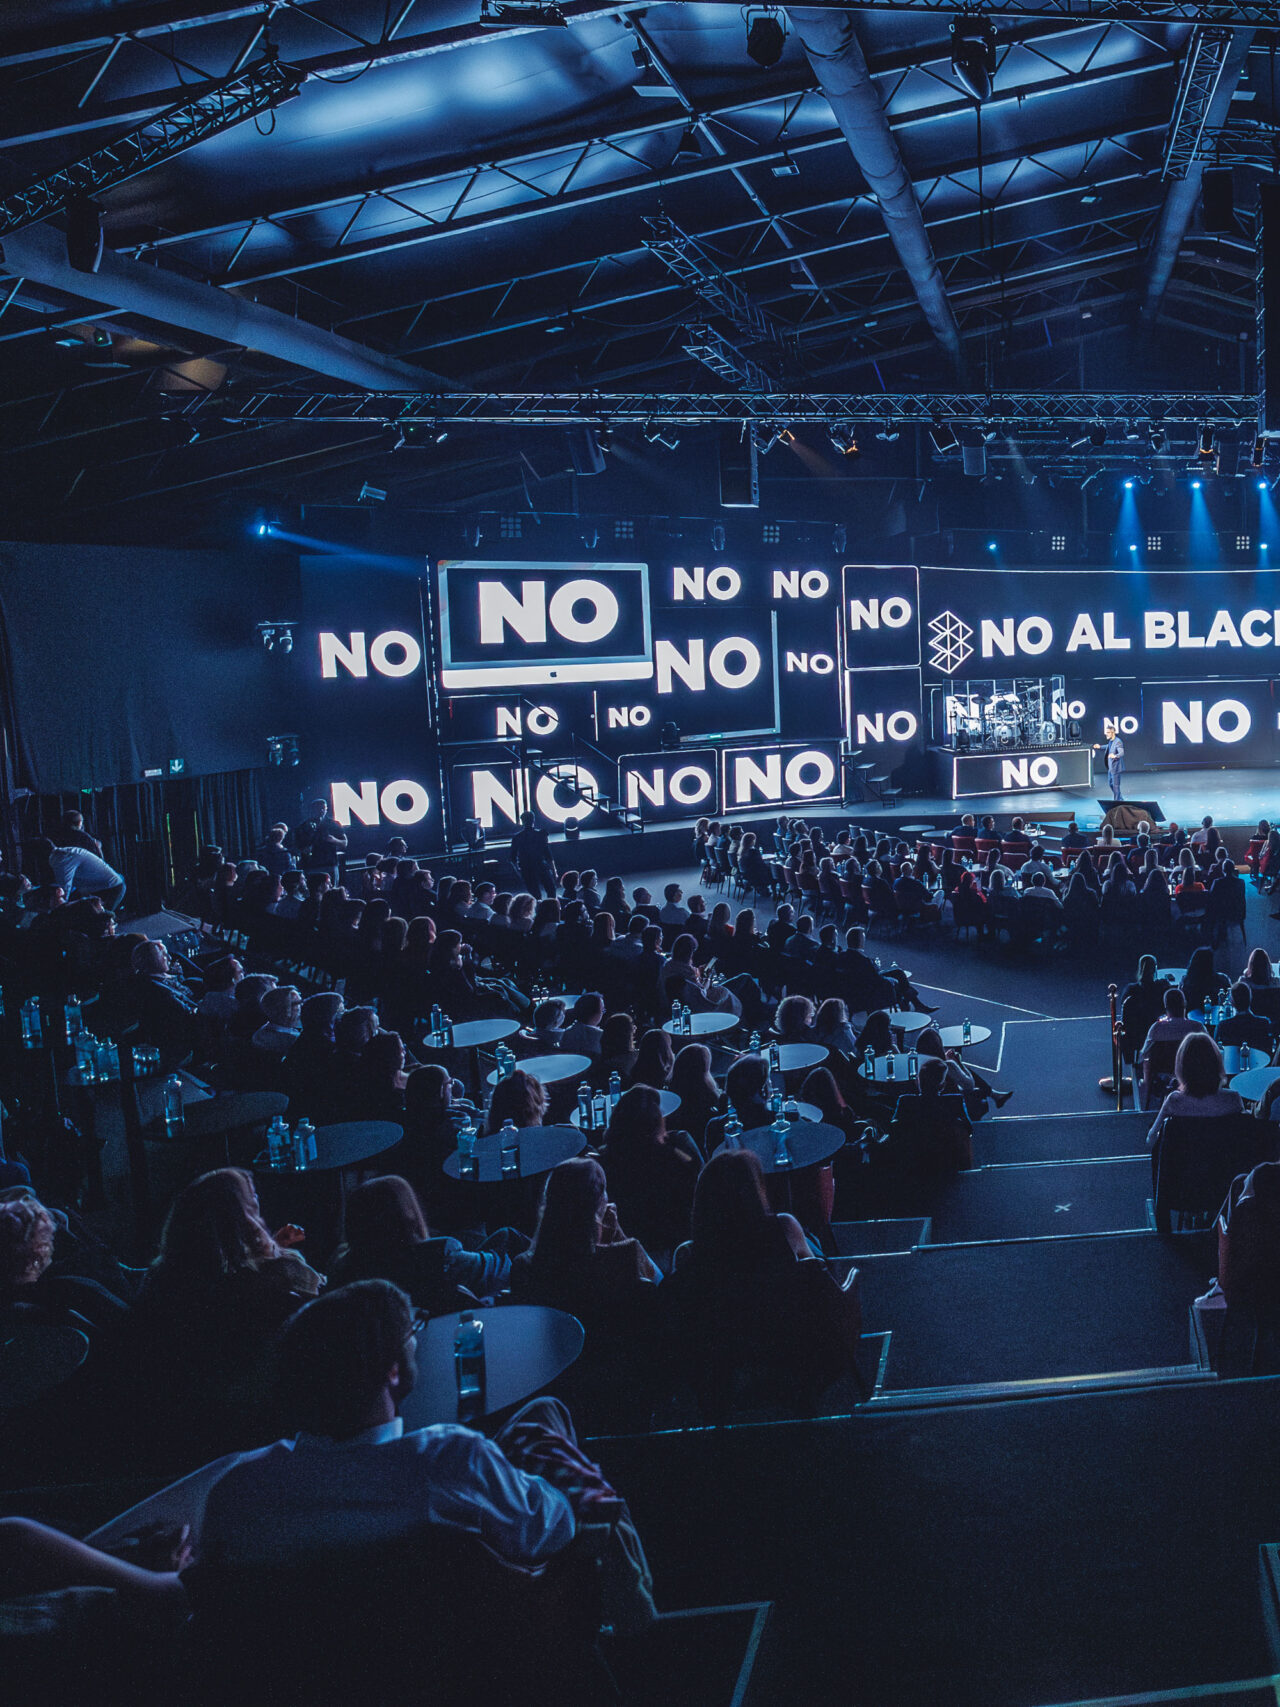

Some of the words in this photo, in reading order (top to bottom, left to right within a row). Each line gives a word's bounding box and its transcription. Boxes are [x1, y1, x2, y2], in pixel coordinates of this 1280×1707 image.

[674, 567, 741, 600] NO
[773, 570, 829, 598] NO
[479, 579, 619, 644] NO
[851, 597, 912, 630] NO
[981, 616, 1053, 658] NO
[1066, 612, 1131, 652] AL
[319, 631, 421, 678] NO
[656, 637, 761, 693] NO
[787, 652, 834, 674] NO
[497, 706, 558, 735] NO
[608, 706, 651, 728] NO
[1052, 700, 1086, 720] NO
[1104, 716, 1138, 735] NO
[1162, 699, 1251, 744] NO
[857, 711, 917, 744] NO
[627, 766, 711, 808] NO
[735, 751, 834, 802] NO
[1002, 756, 1058, 788] NO
[331, 780, 429, 826] NO
[472, 765, 599, 827] NO
